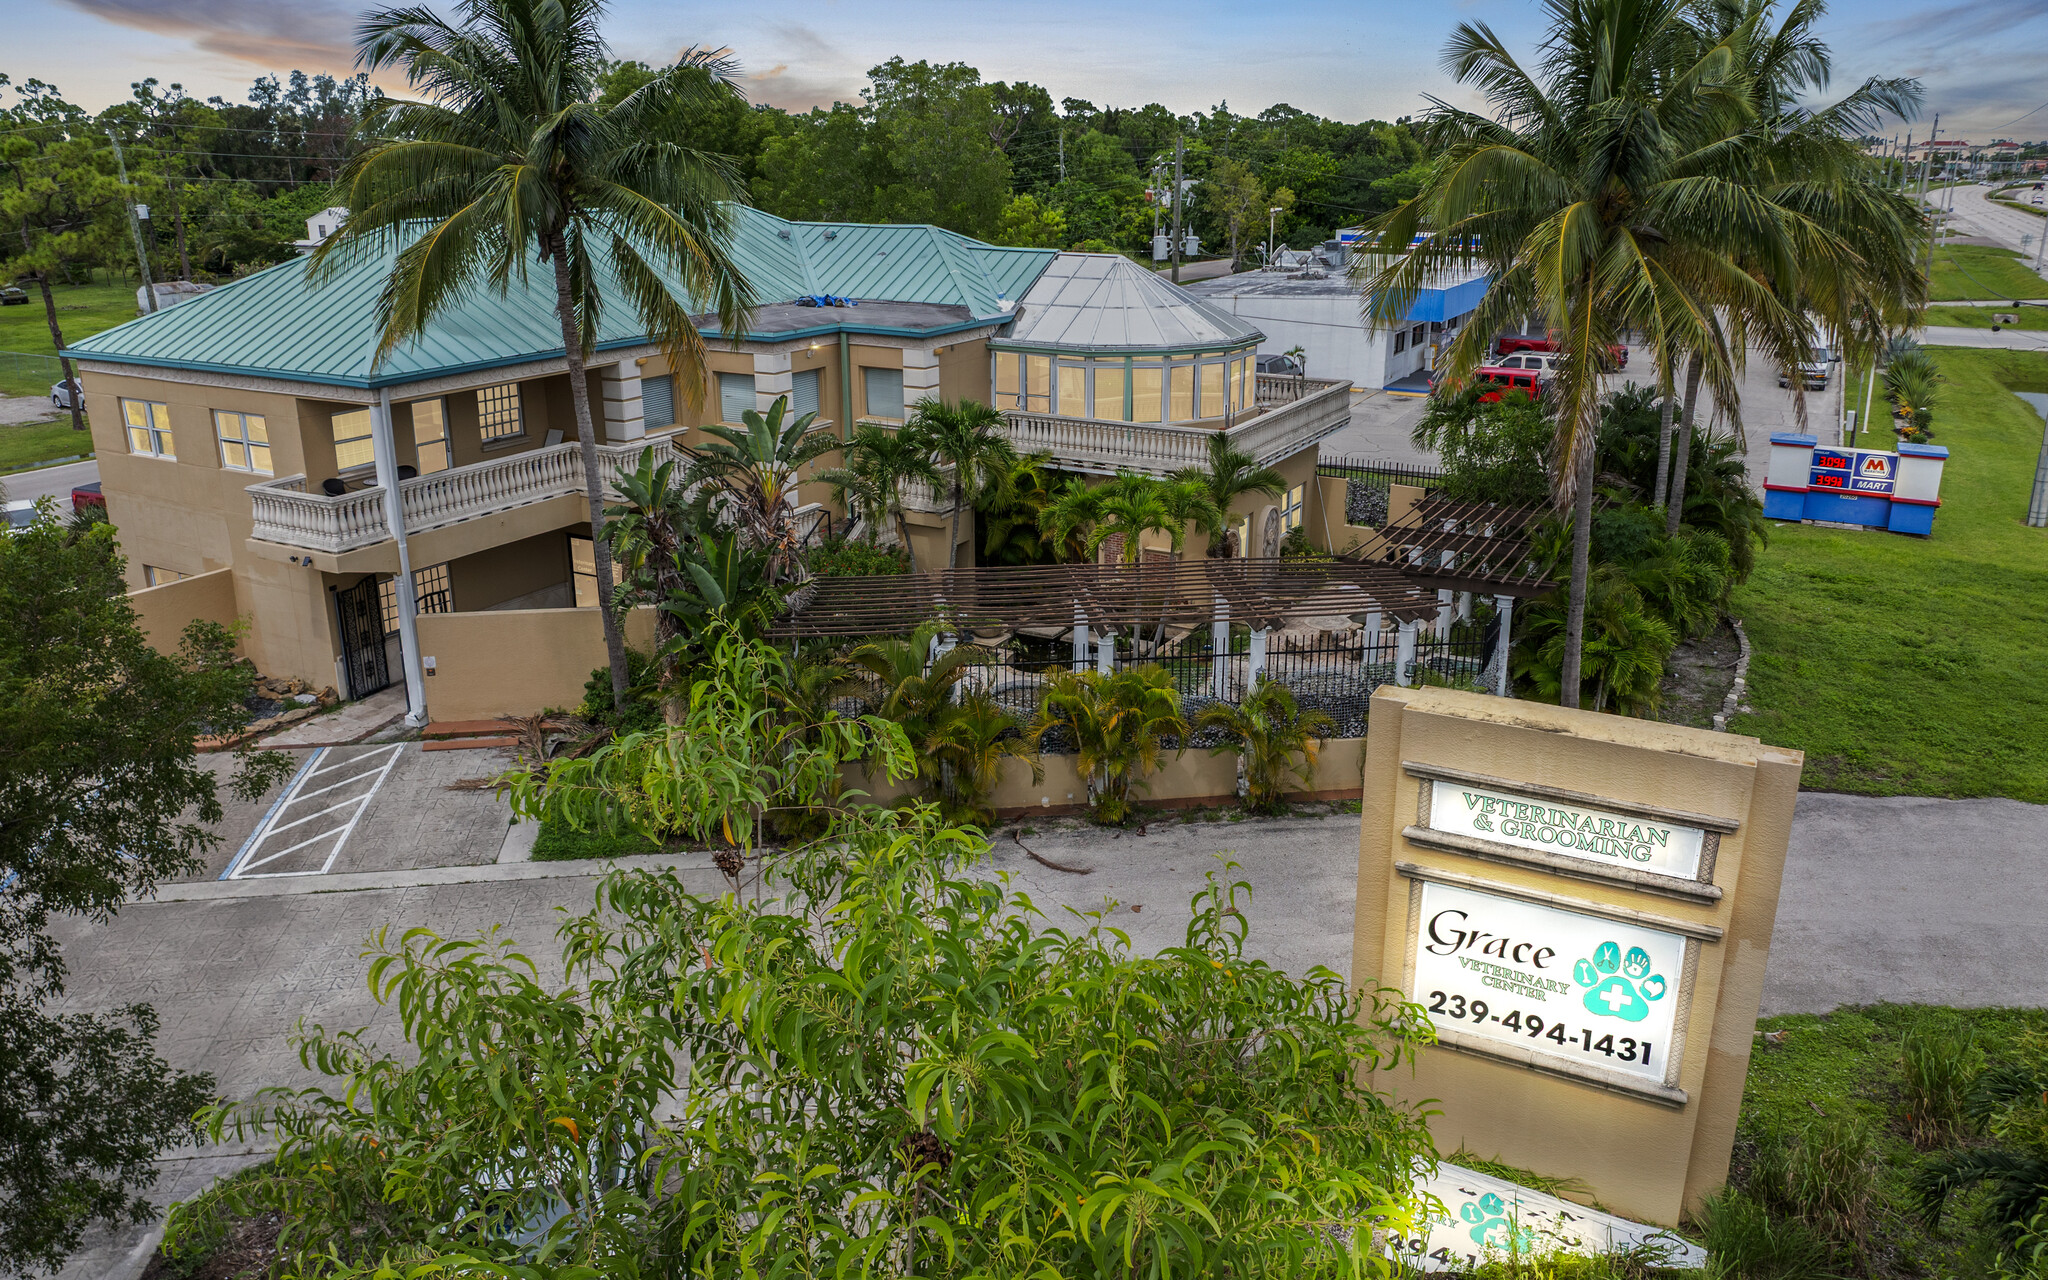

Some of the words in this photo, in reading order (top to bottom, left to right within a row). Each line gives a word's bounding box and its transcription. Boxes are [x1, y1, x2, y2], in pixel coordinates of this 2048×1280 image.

[1856, 481, 1888, 491] MART
[1462, 792, 1670, 848] VETERINARIAN
[1473, 813, 1494, 832] &
[1500, 818, 1652, 862] GROOMING
[1425, 909, 1556, 969] Grace
[1458, 956, 1570, 995] VETERINARY
[1481, 975, 1546, 1002] CENTER
[1428, 990, 1652, 1065] 239-494-1431
